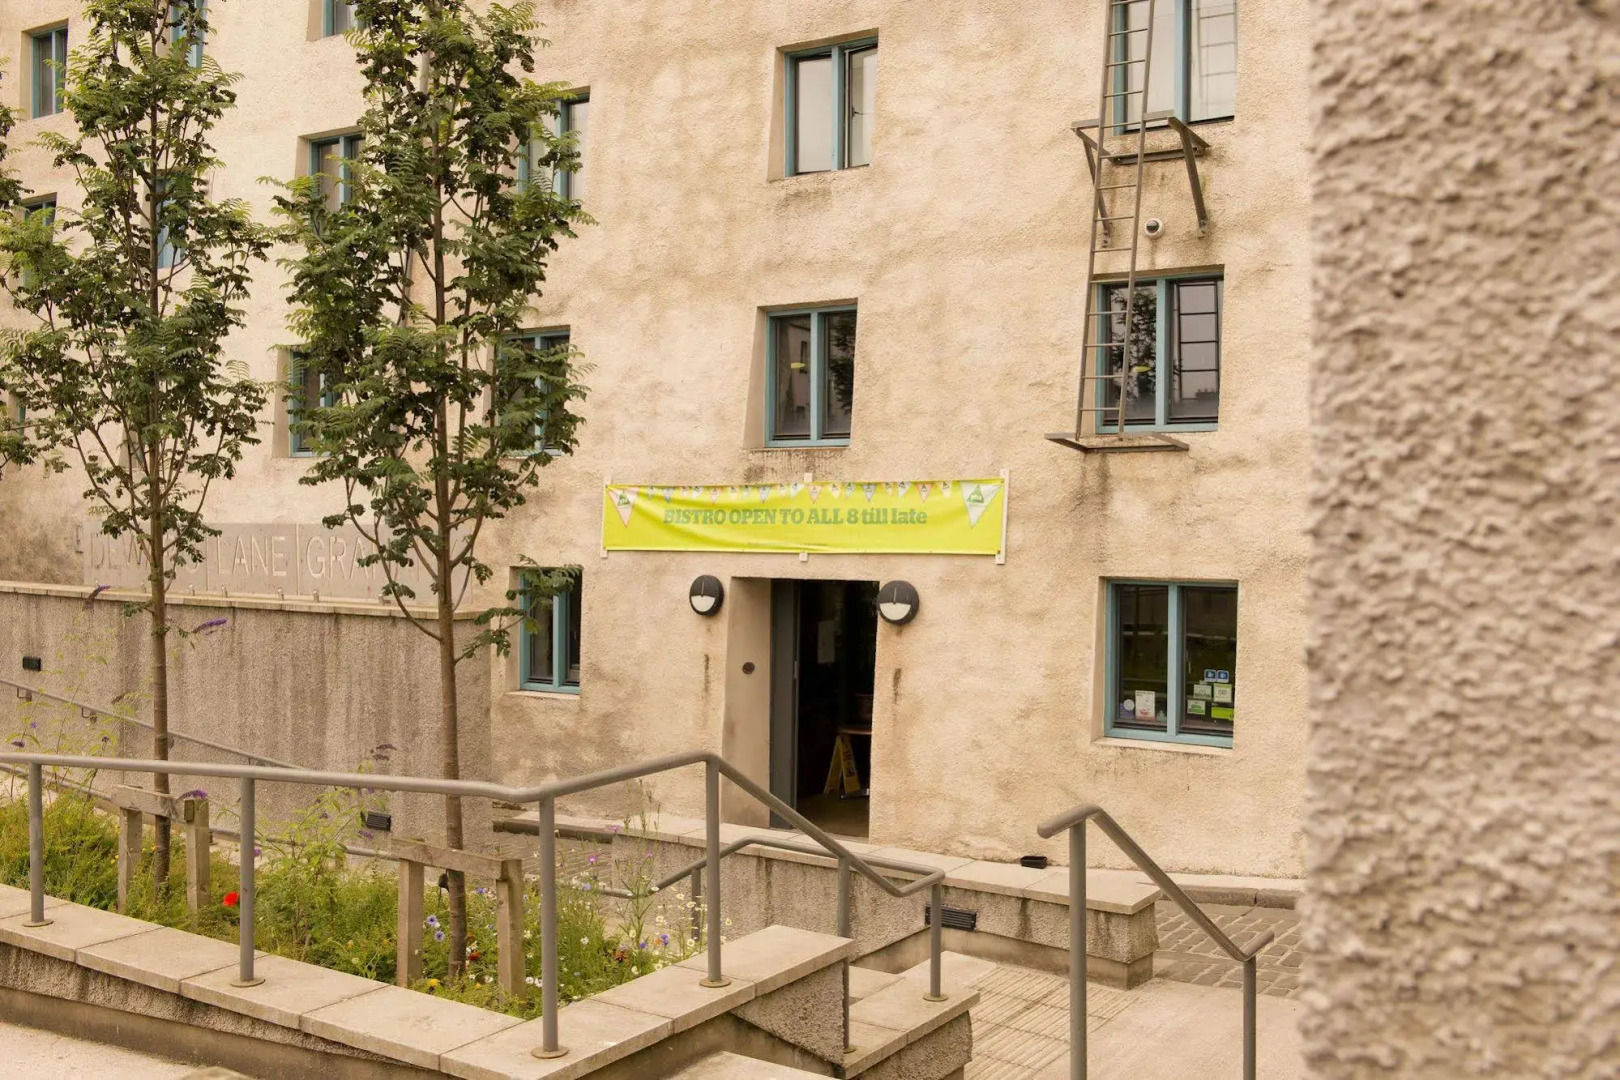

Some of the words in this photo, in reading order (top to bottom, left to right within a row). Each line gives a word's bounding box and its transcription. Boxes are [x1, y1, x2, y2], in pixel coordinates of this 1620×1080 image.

[663, 508, 726, 525] BISTRO
[729, 509, 777, 525] OPEN
[779, 508, 804, 525] TO
[806, 508, 844, 525] ALL
[846, 507, 860, 525] 8
[861, 507, 888, 525] till
[891, 507, 928, 525] late
[216, 535, 287, 577] LANE
